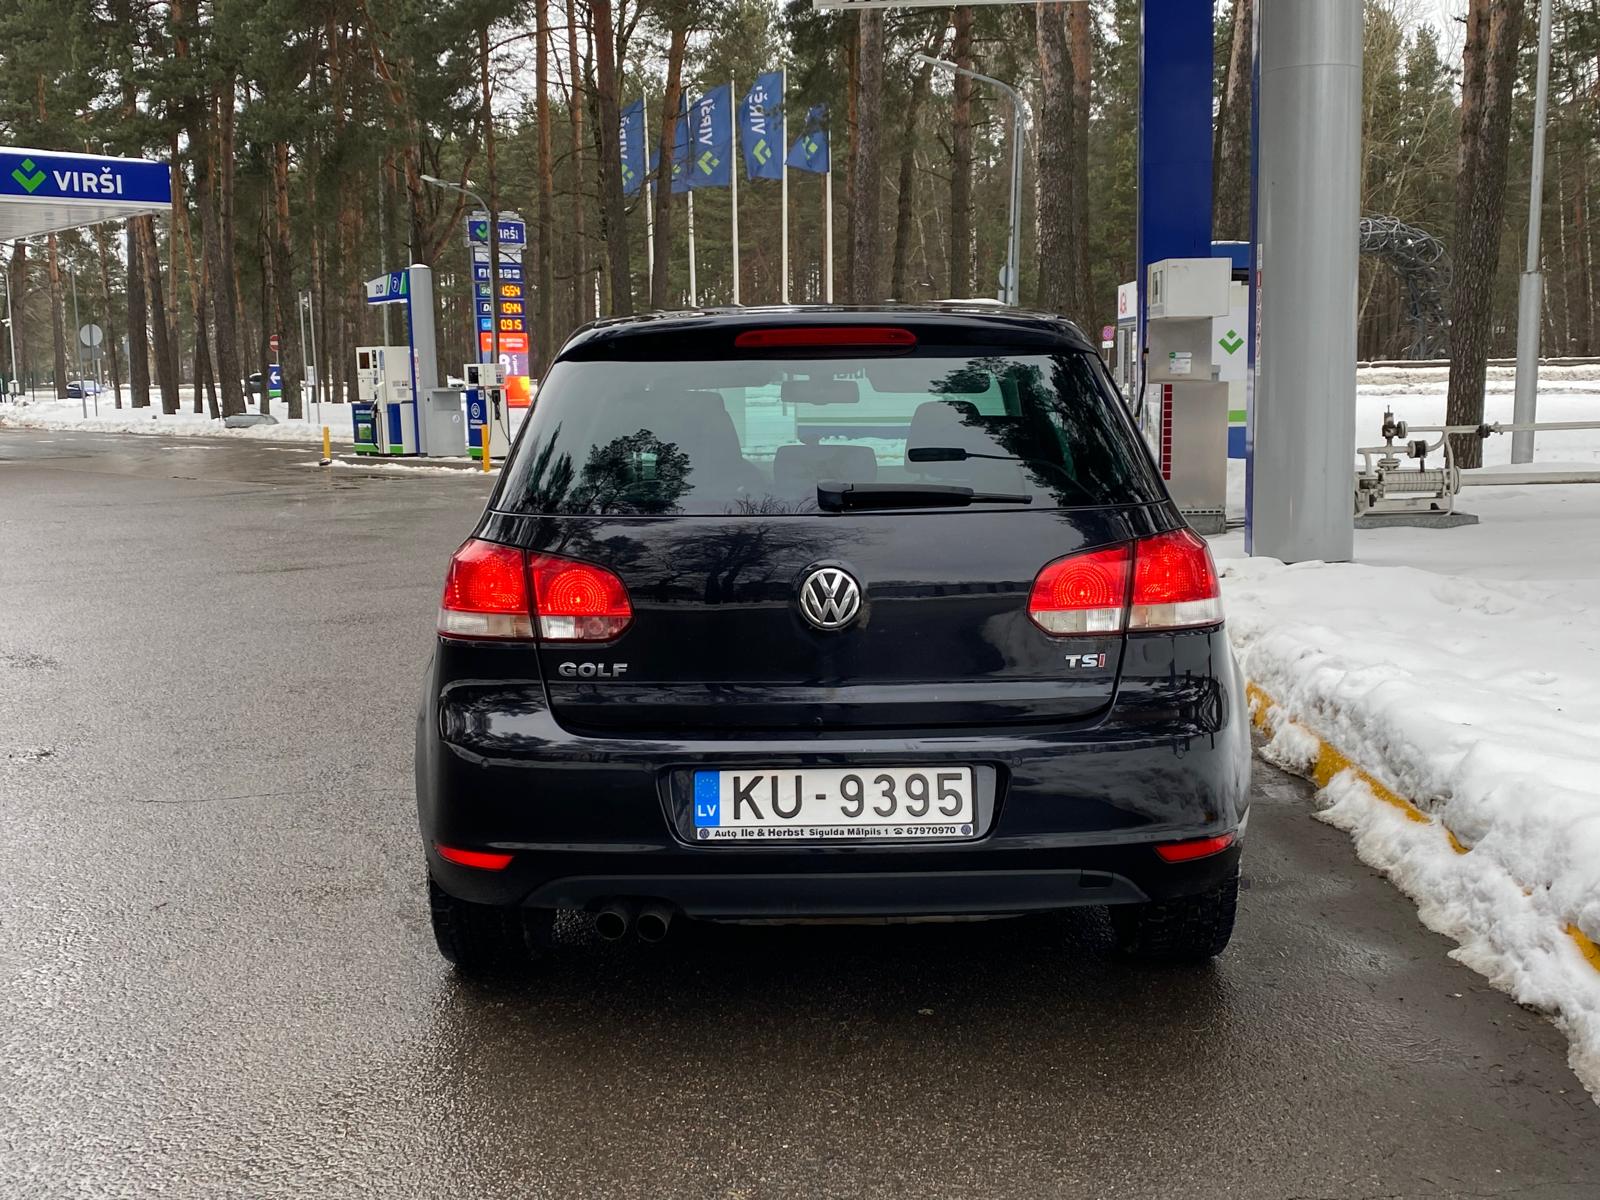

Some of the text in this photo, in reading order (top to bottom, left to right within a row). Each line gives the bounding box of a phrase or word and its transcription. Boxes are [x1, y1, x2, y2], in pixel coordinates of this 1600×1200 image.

[53, 166, 123, 194] VIRŠI
[498, 226, 519, 240] IRŠI
[558, 661, 628, 677] GOLF
[698, 805, 717, 817] LV
[714, 826, 956, 838] Auto Ile & Herbst Sigulda Mālpils 1 67970970
